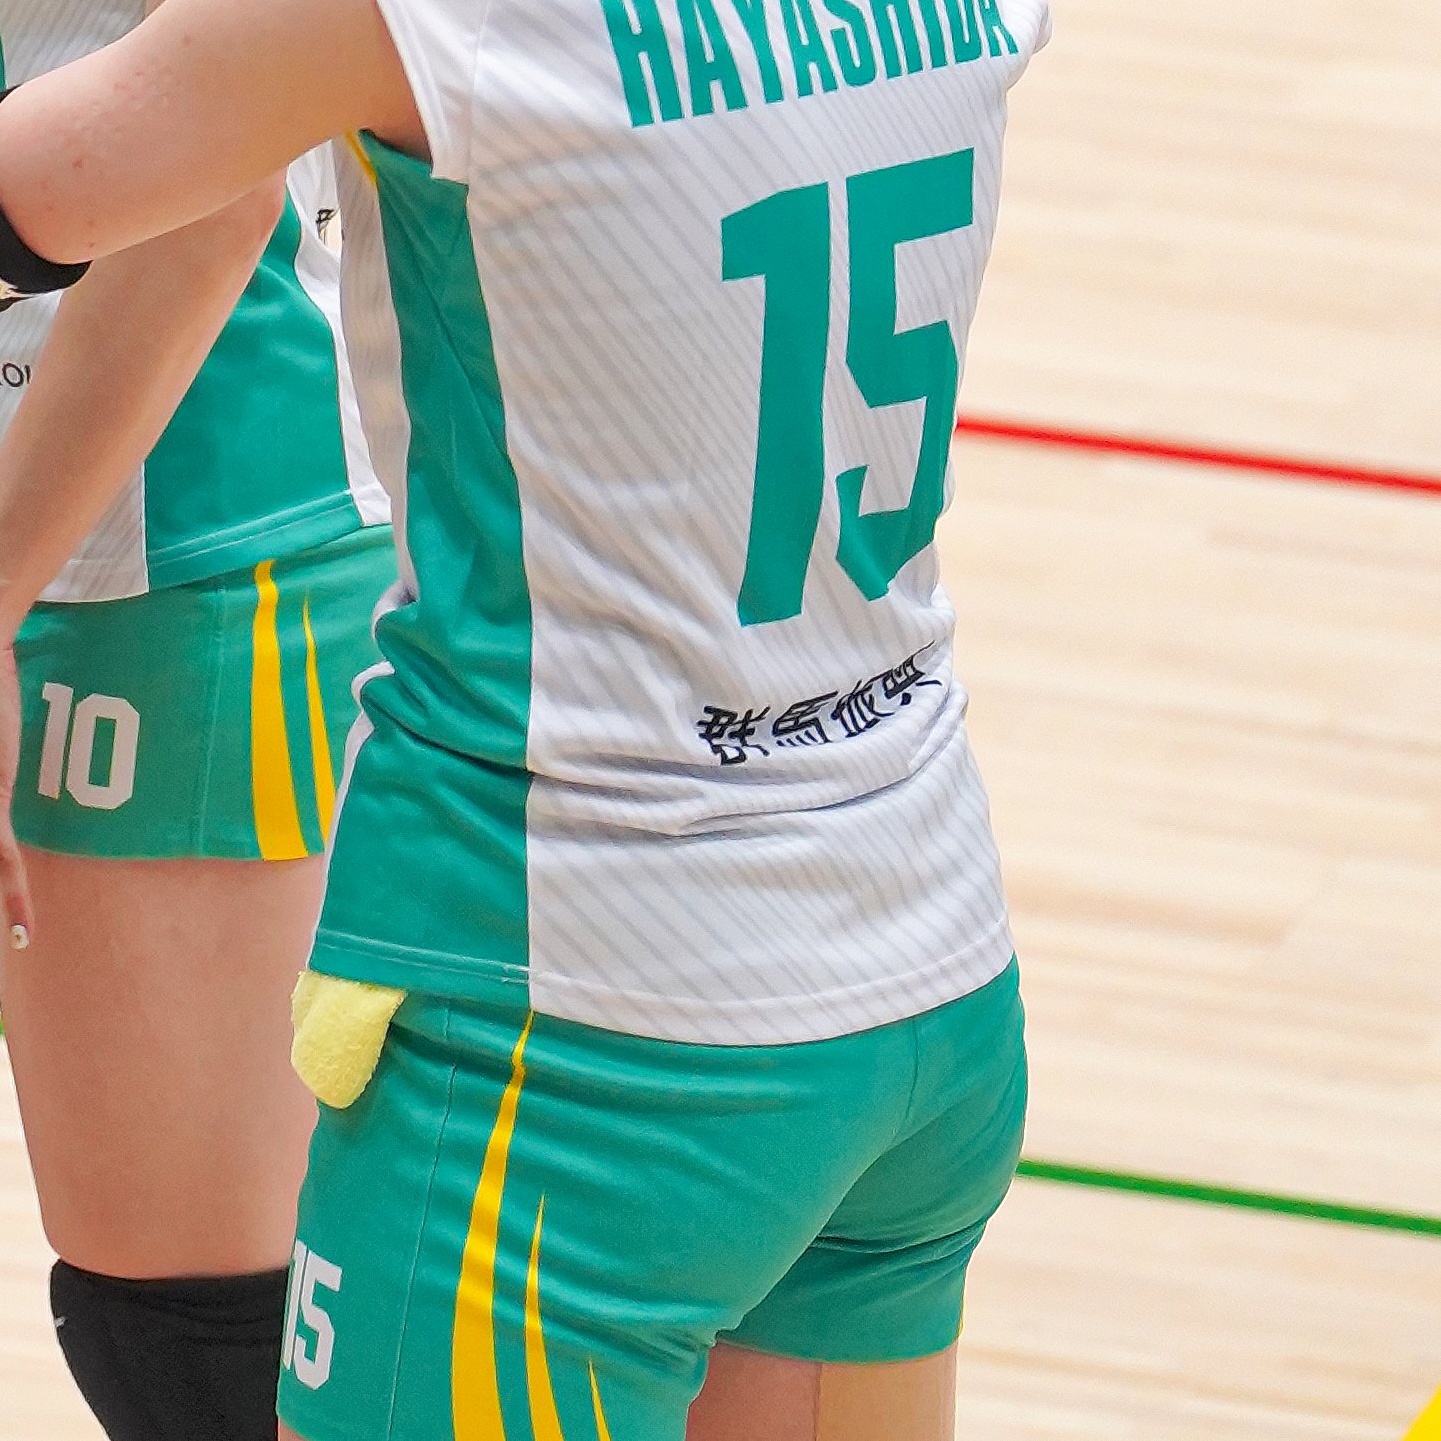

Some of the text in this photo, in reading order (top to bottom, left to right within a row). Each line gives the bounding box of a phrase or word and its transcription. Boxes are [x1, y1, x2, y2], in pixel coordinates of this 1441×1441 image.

[721, 147, 975, 628] 15
[37, 681, 141, 810] 10
[282, 1238, 343, 1391] 15
